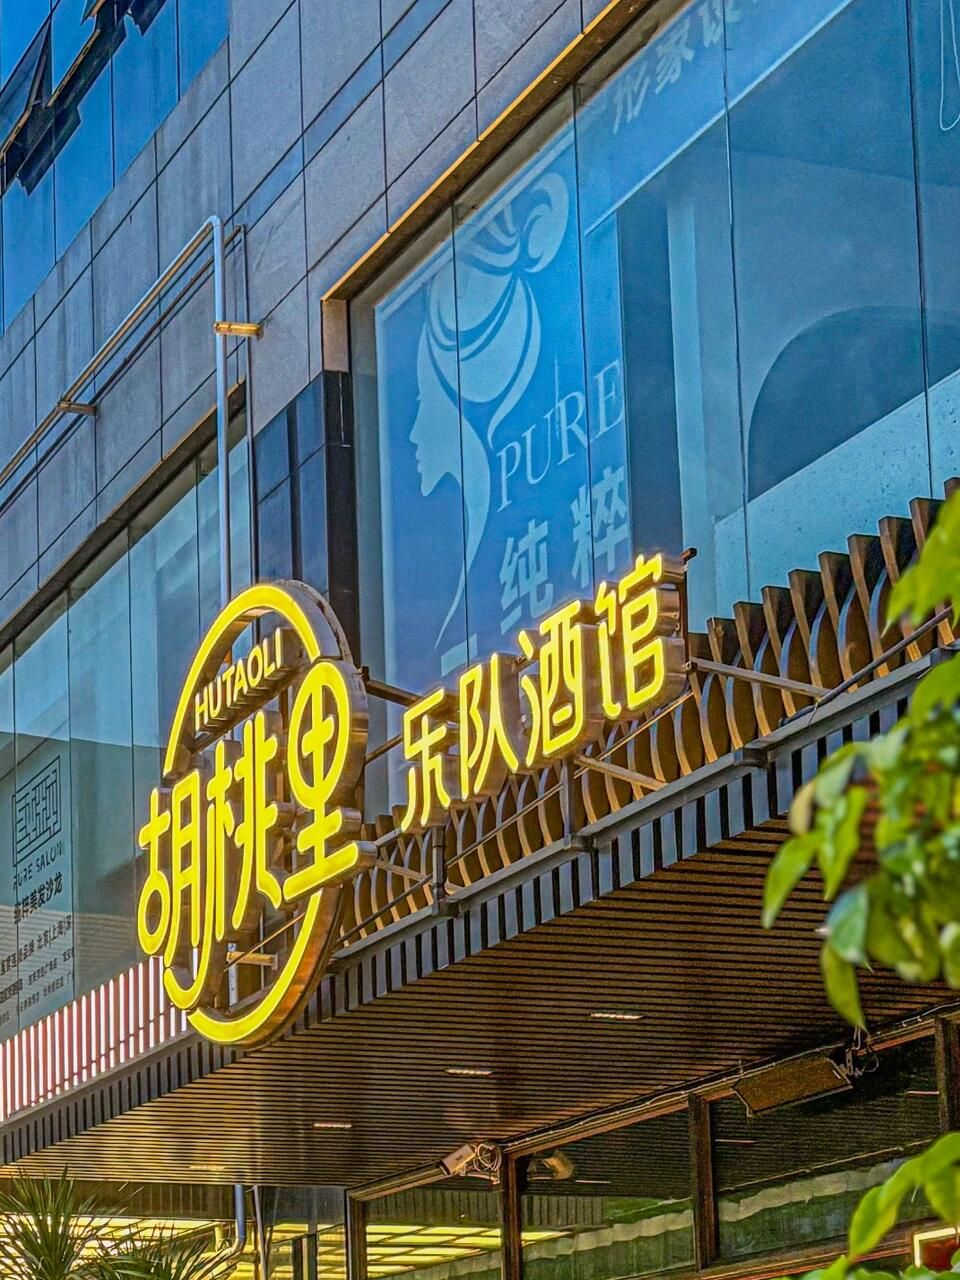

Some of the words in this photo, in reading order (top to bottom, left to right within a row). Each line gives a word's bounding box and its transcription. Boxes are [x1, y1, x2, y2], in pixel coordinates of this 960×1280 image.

[496, 360, 626, 513] PURE
[499, 466, 630, 635] 纯粹
[195, 627, 281, 732] HUTAOLI
[401, 553, 666, 833] 乐队酒馆
[138, 661, 359, 1010] 胡桃里
